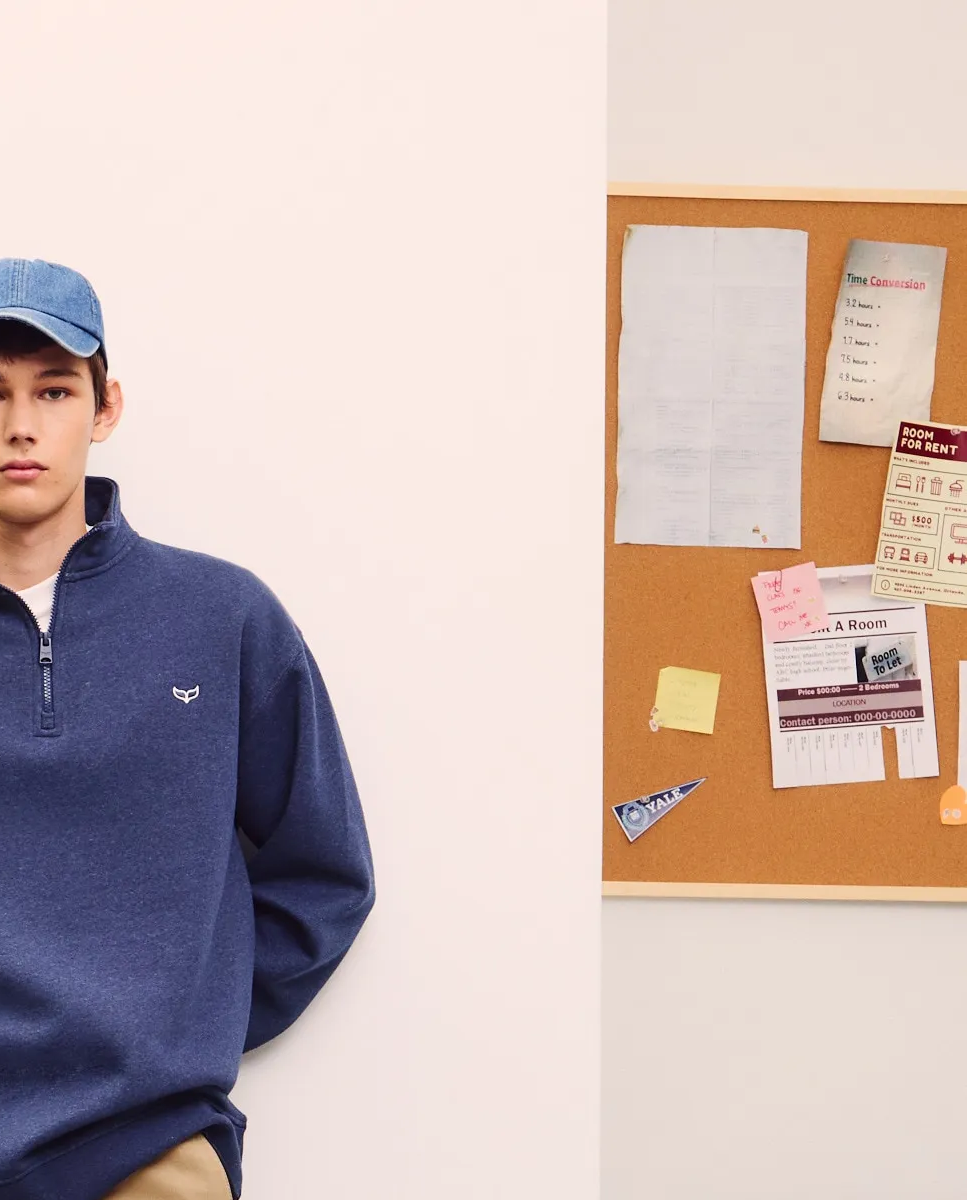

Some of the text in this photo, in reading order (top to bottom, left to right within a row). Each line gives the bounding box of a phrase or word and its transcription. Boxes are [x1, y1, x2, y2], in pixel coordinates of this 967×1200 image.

[847, 273, 926, 290] Time Conversion
[902, 426, 934, 441] ROOM
[900, 438, 959, 456] FOR RENT
[912, 515, 932, 524] $500
[835, 621, 844, 632] A
[848, 619, 887, 631] Room
[871, 647, 898, 666] Room
[874, 656, 902, 676] To Let
[798, 688, 815, 696] Price
[816, 686, 841, 696] $00:00
[865, 682, 899, 691] Bedrooms
[832, 699, 867, 708] LOCATION
[780, 709, 916, 728] Contact person: 000-00-0000
[645, 787, 684, 814] YALE
